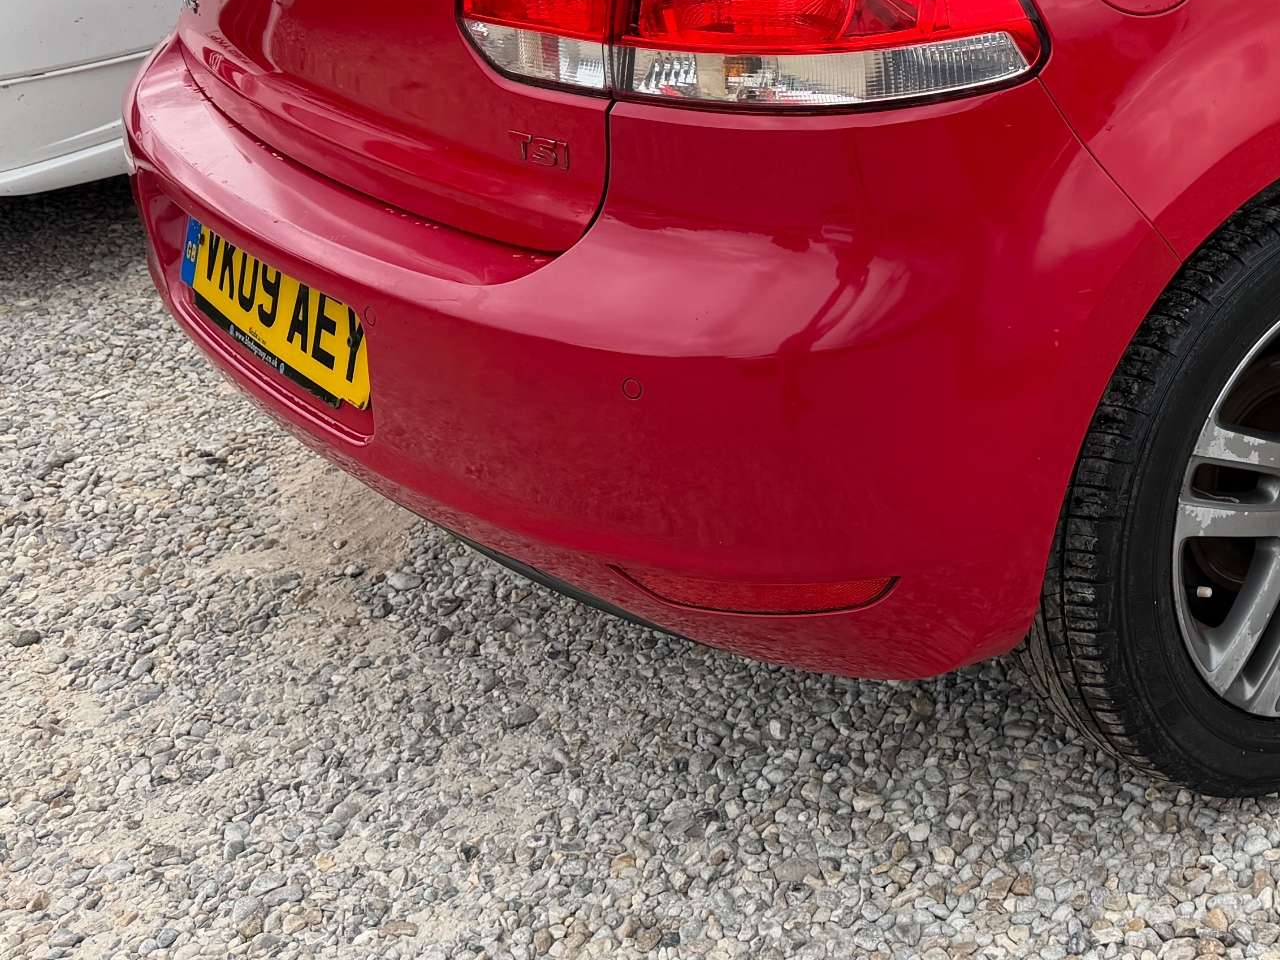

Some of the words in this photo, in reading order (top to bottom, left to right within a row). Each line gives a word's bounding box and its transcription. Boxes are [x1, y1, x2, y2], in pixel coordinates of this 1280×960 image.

[507, 130, 569, 171] TSI
[186, 240, 197, 262] GB
[206, 230, 281, 328] VK09
[286, 282, 365, 383] AEY
